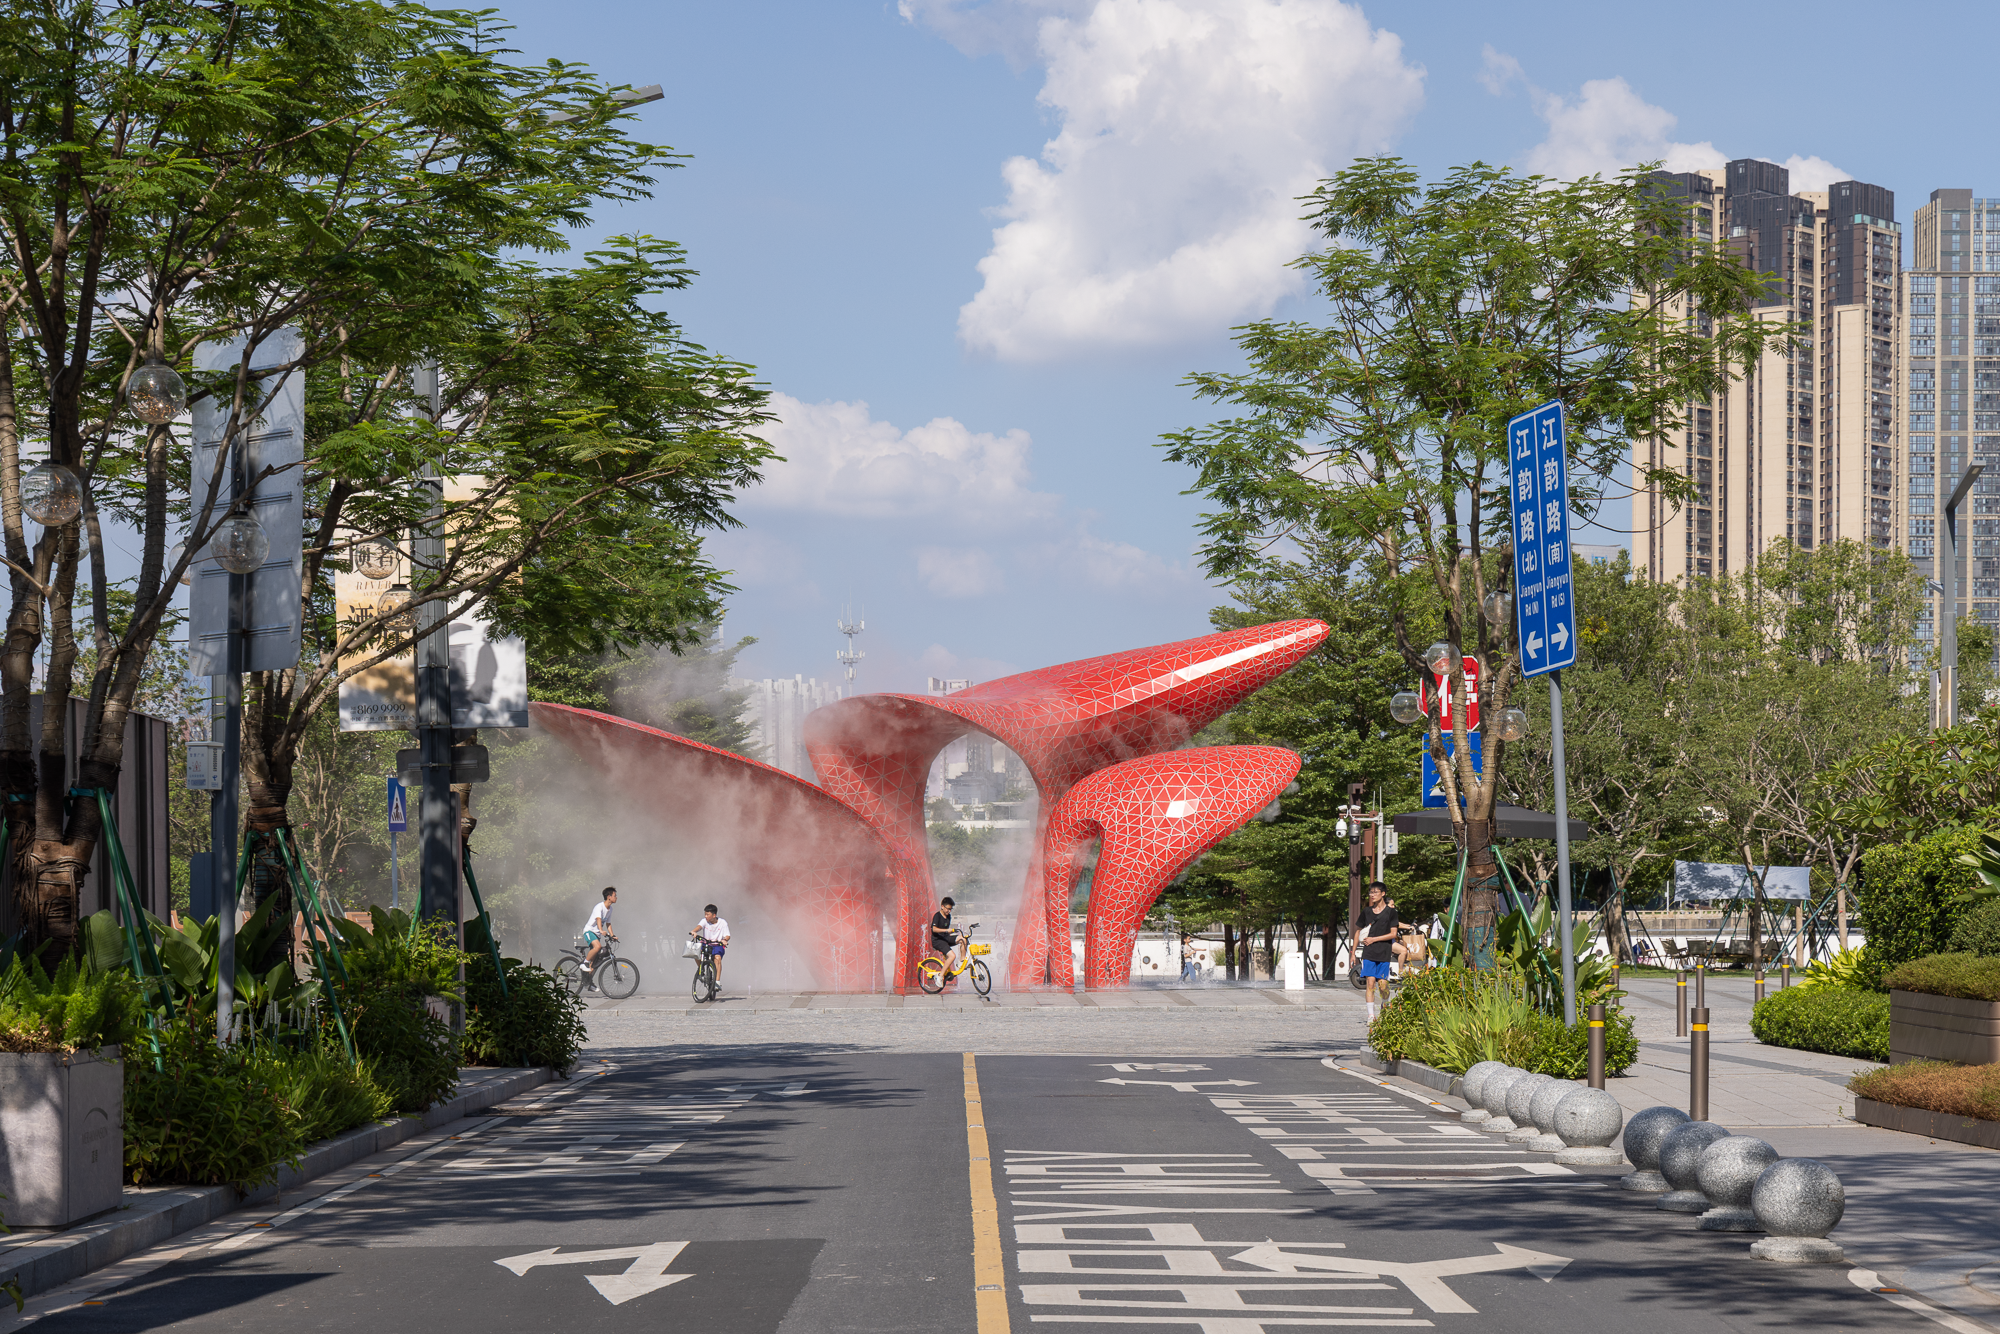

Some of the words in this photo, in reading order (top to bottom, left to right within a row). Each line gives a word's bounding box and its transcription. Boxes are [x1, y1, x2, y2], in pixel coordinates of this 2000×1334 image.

[356, 581, 392, 590] RIVER
[1520, 581, 1542, 598] Jiangyun
[1546, 572, 1568, 591] Jiangyun
[1525, 603, 1532, 617] Rd
[1551, 594, 1558, 608] Rd
[357, 704, 379, 715] 8169
[380, 703, 406, 714] 9999
[1199, 1092, 1460, 1124] PARK
[1247, 1125, 1527, 1160] THE
[1002, 1149, 1294, 1195] WAY
[1298, 1162, 1609, 1196] TO
